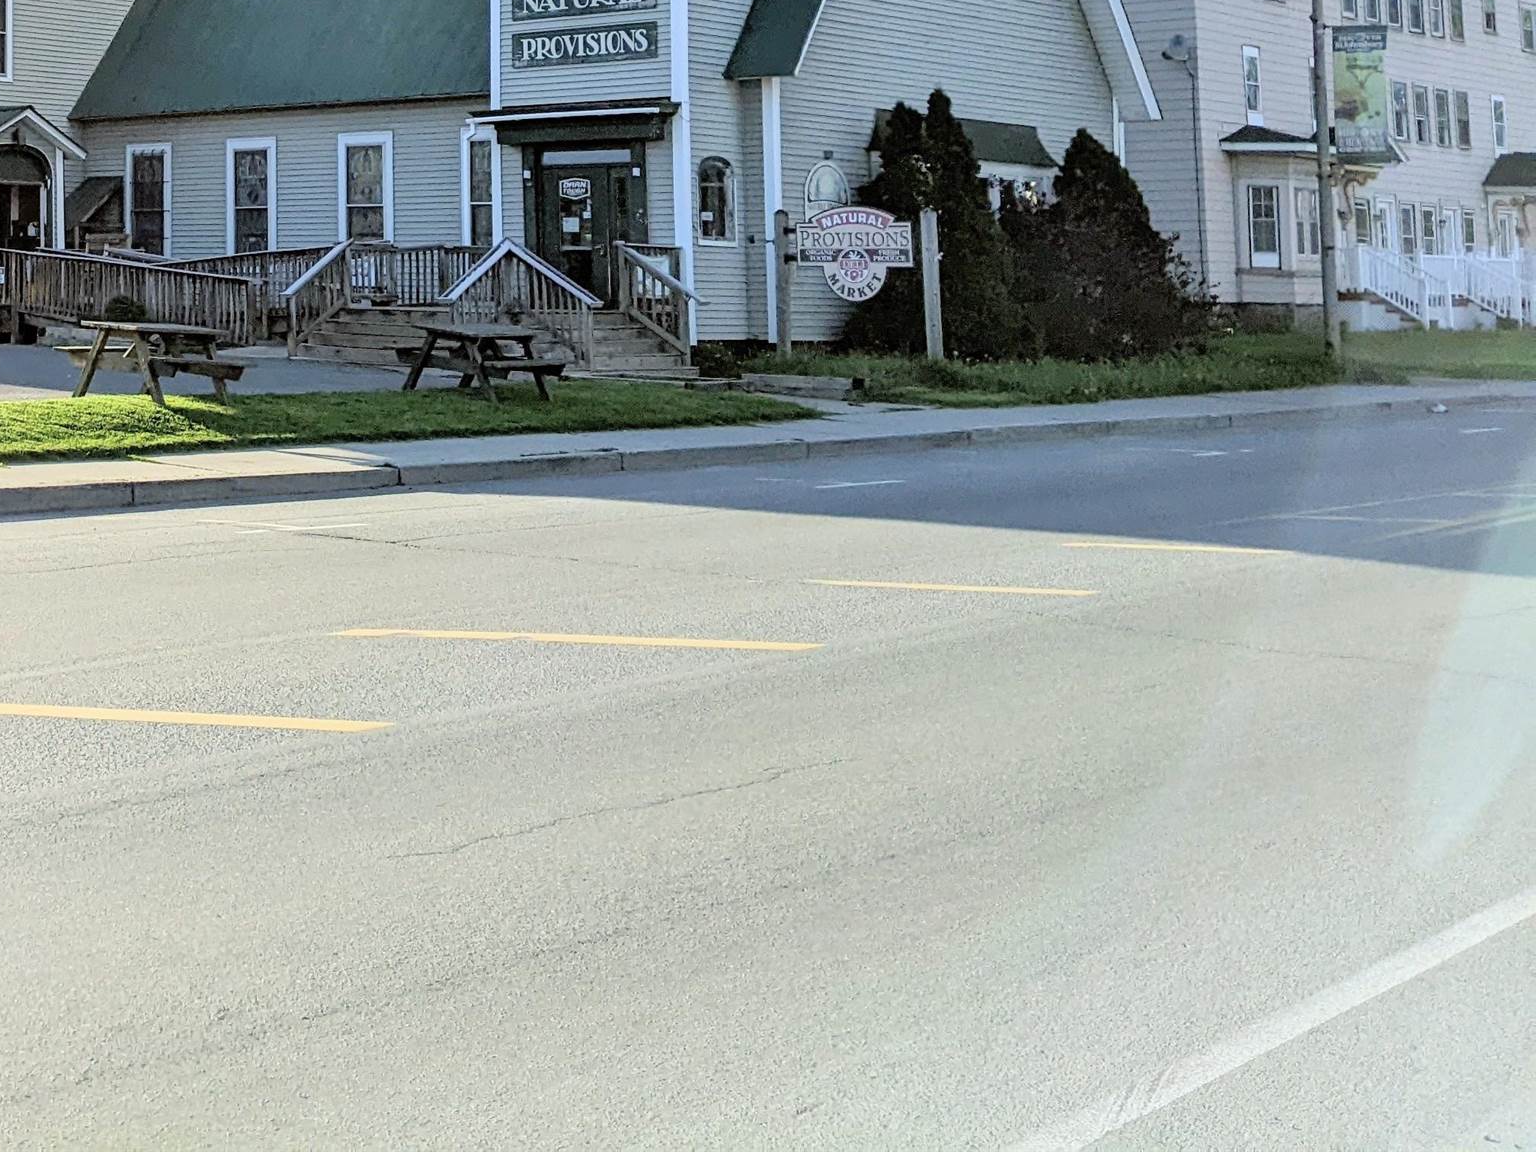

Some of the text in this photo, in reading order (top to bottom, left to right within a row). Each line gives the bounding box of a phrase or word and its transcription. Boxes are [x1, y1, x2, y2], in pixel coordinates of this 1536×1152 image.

[520, 28, 649, 61] PROVISIONS
[821, 212, 885, 229] NATURAL
[800, 230, 910, 248] PROVISIONS
[828, 272, 882, 298] MARKET
